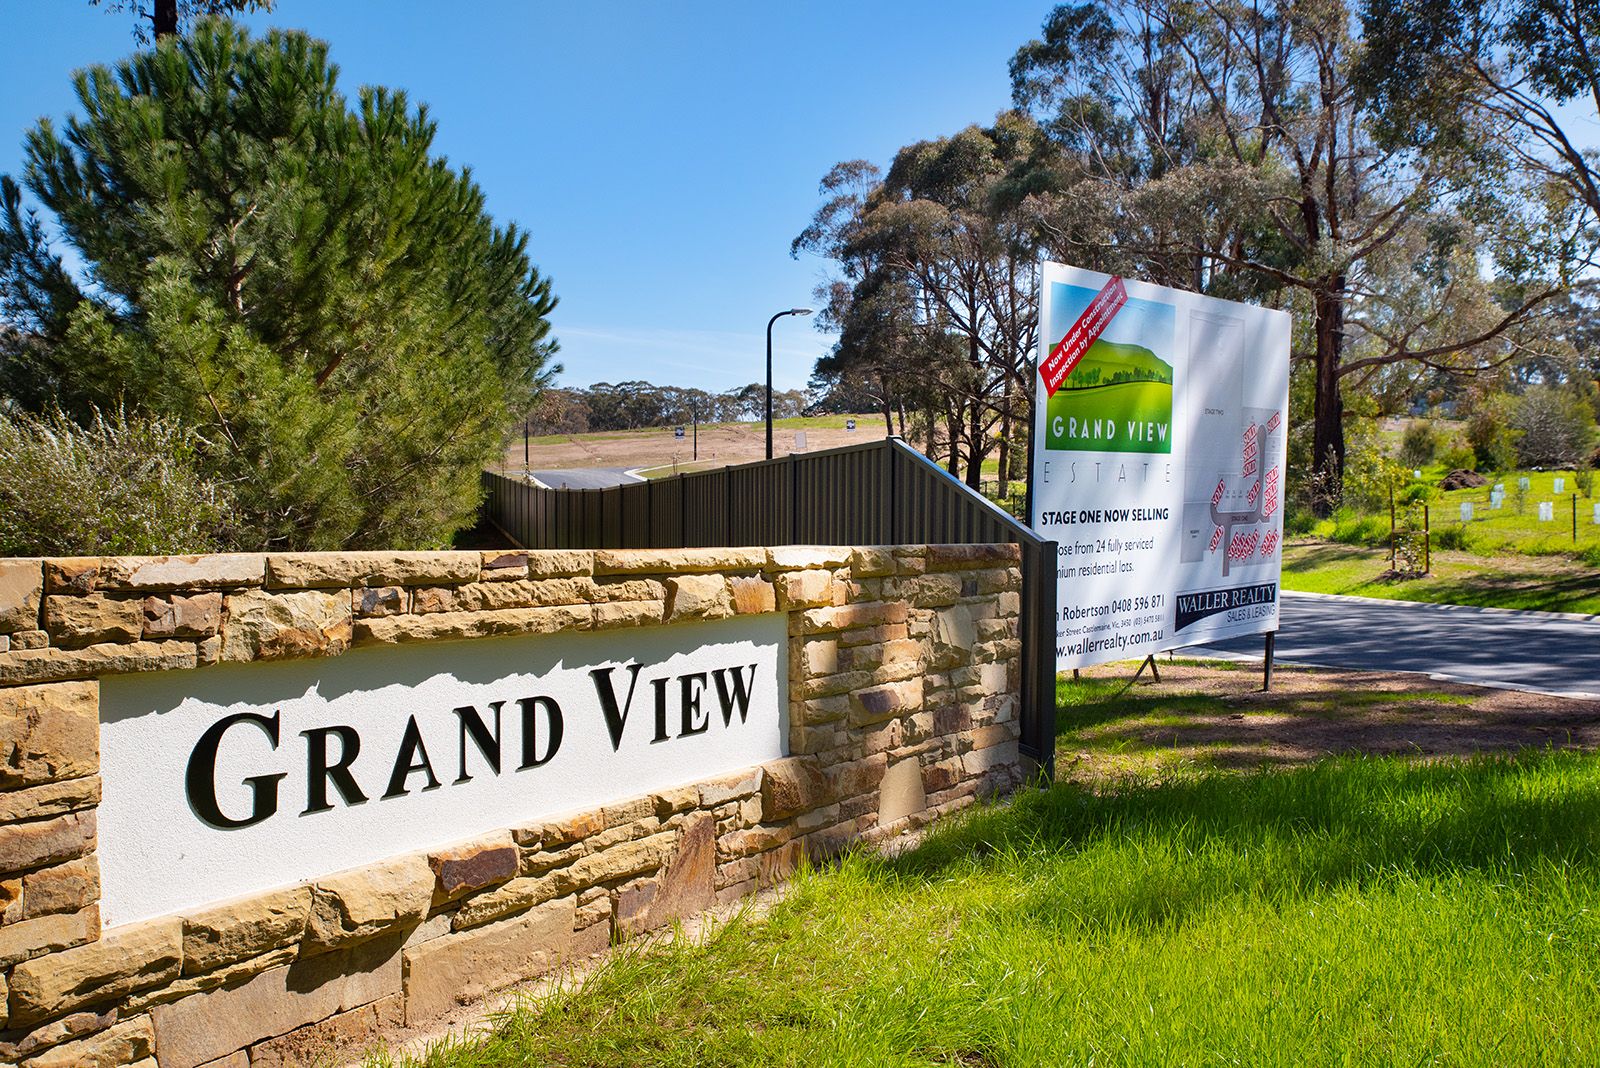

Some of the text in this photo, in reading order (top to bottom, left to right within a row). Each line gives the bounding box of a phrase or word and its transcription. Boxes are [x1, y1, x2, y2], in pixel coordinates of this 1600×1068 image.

[1048, 284, 1117, 371] Now Under Construction
[1050, 292, 1124, 388] Inspection by Appointment
[1052, 416, 1168, 442] GRAND VIEW
[1044, 461, 1171, 483] ESTATE
[1042, 508, 1169, 525] STAGE ONE NOW SELLING
[1057, 537, 1154, 556] ose from 24 fully serviced
[1078, 560, 1117, 577] residential
[1119, 560, 1134, 573] lots.
[1063, 604, 1109, 620] Robertson
[1112, 599, 1131, 613] 0408
[1134, 596, 1149, 611] 596
[1152, 594, 1164, 607] 871
[1179, 585, 1275, 613] WALLER REALTY
[1227, 604, 1275, 622] SALES & LEASING
[1056, 629, 1163, 658] w.wallerrealty.com.au
[185, 662, 758, 832] GRAND VIEW
